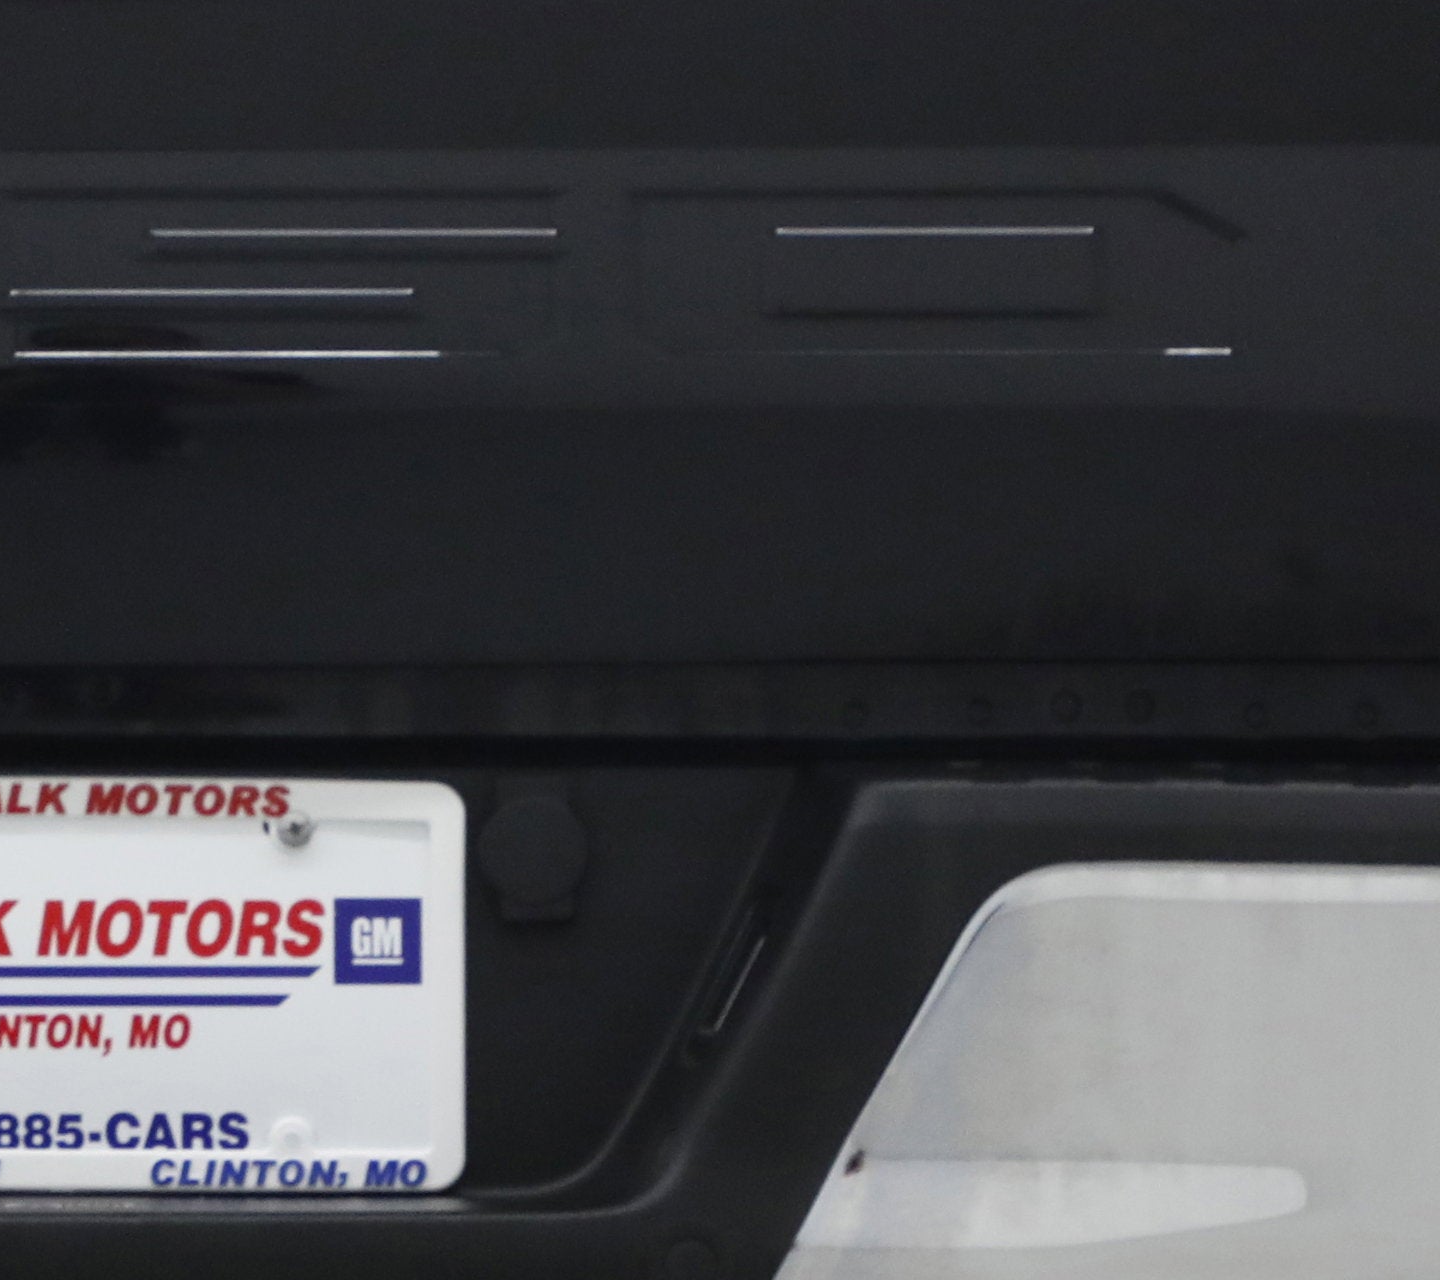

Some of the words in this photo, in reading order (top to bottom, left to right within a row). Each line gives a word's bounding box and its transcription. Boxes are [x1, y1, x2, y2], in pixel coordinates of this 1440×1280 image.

[87, 784, 289, 817] MOTORS
[37, 898, 326, 959] MOTORS
[351, 917, 402, 957] GM
[129, 1013, 191, 1050] MO
[151, 1158, 348, 1186] CLINTON,
[366, 1159, 428, 1186] MO
